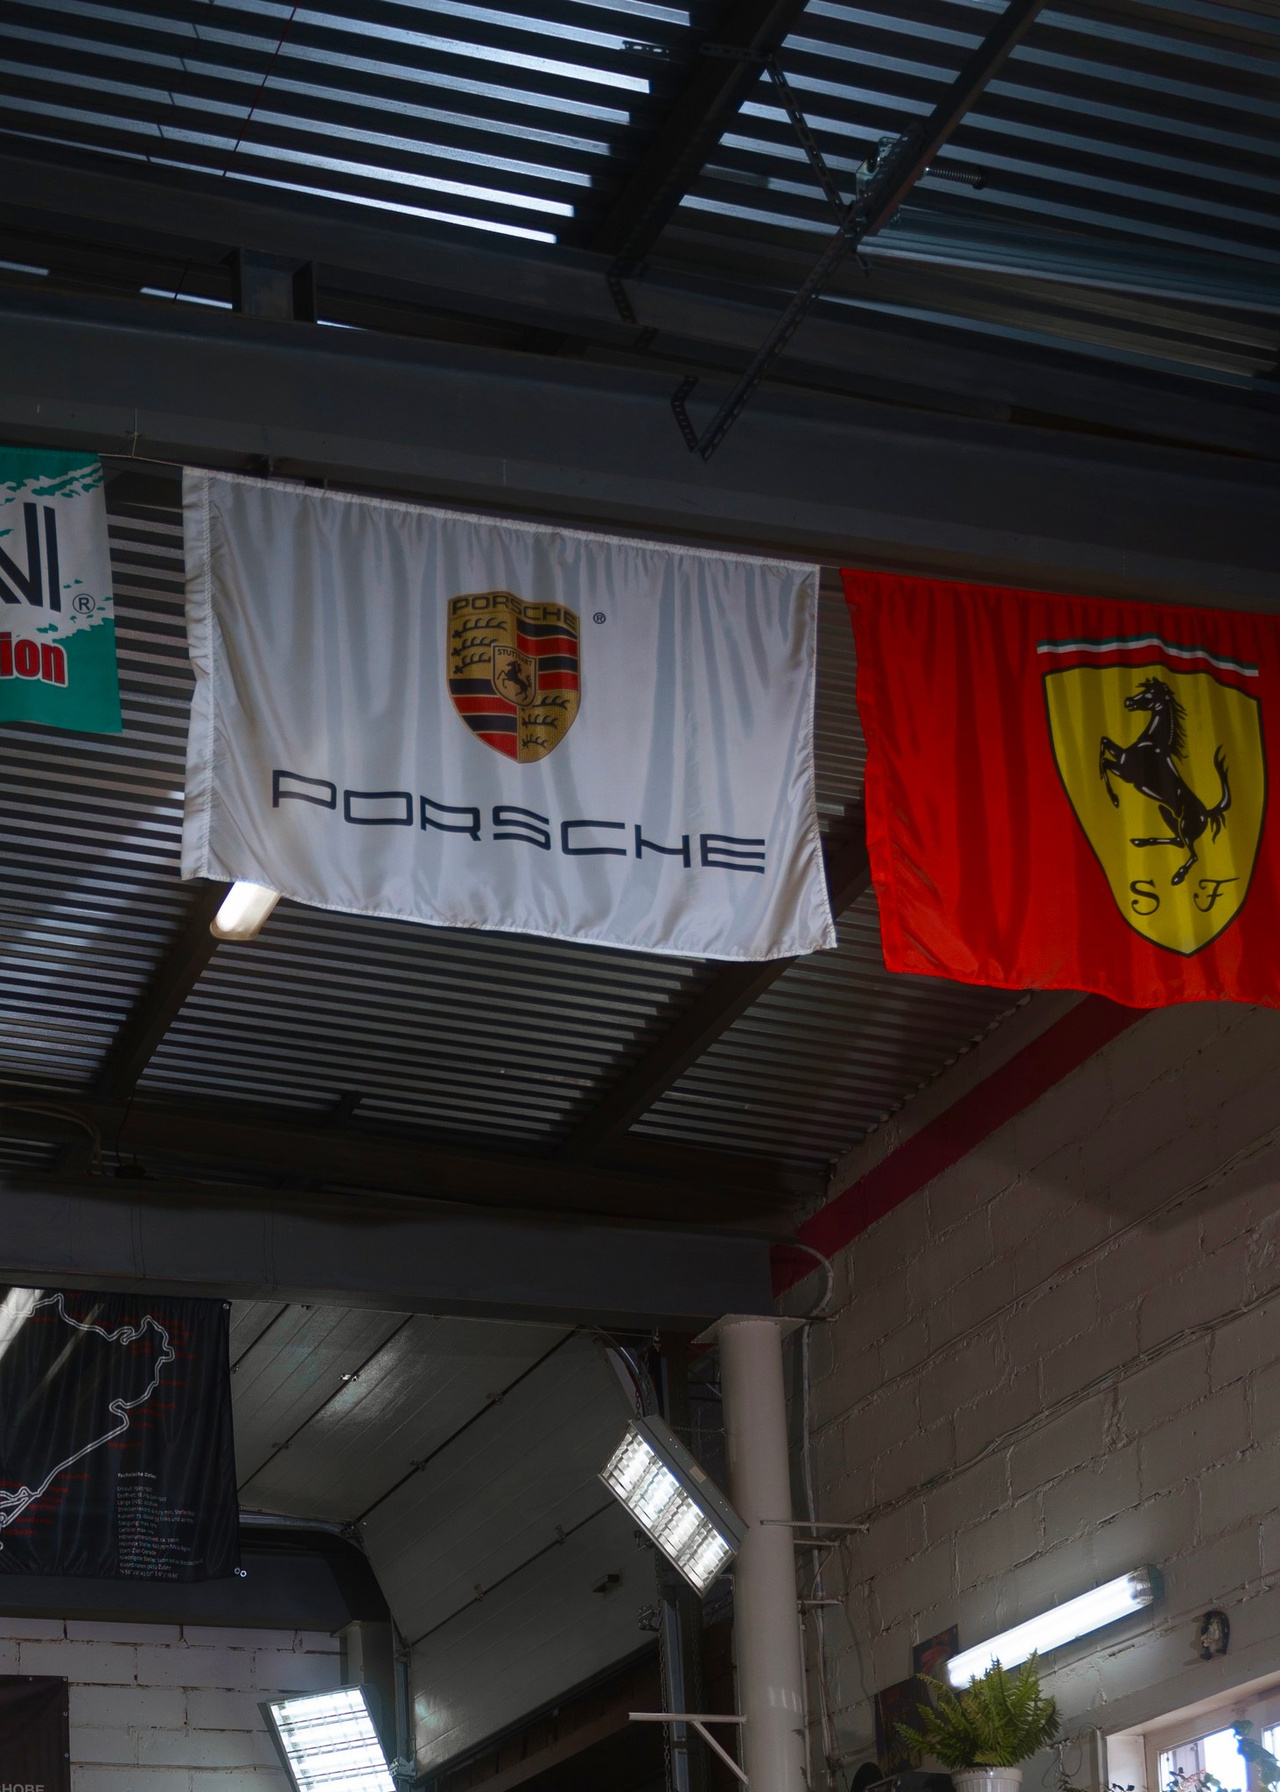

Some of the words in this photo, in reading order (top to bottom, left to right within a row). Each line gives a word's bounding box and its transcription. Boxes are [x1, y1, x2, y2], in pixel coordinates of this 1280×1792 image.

[452, 595, 577, 630] PORSCHE
[272, 770, 767, 875] PORSCHE
[1130, 879, 1160, 915] S
[1193, 877, 1239, 914] F
